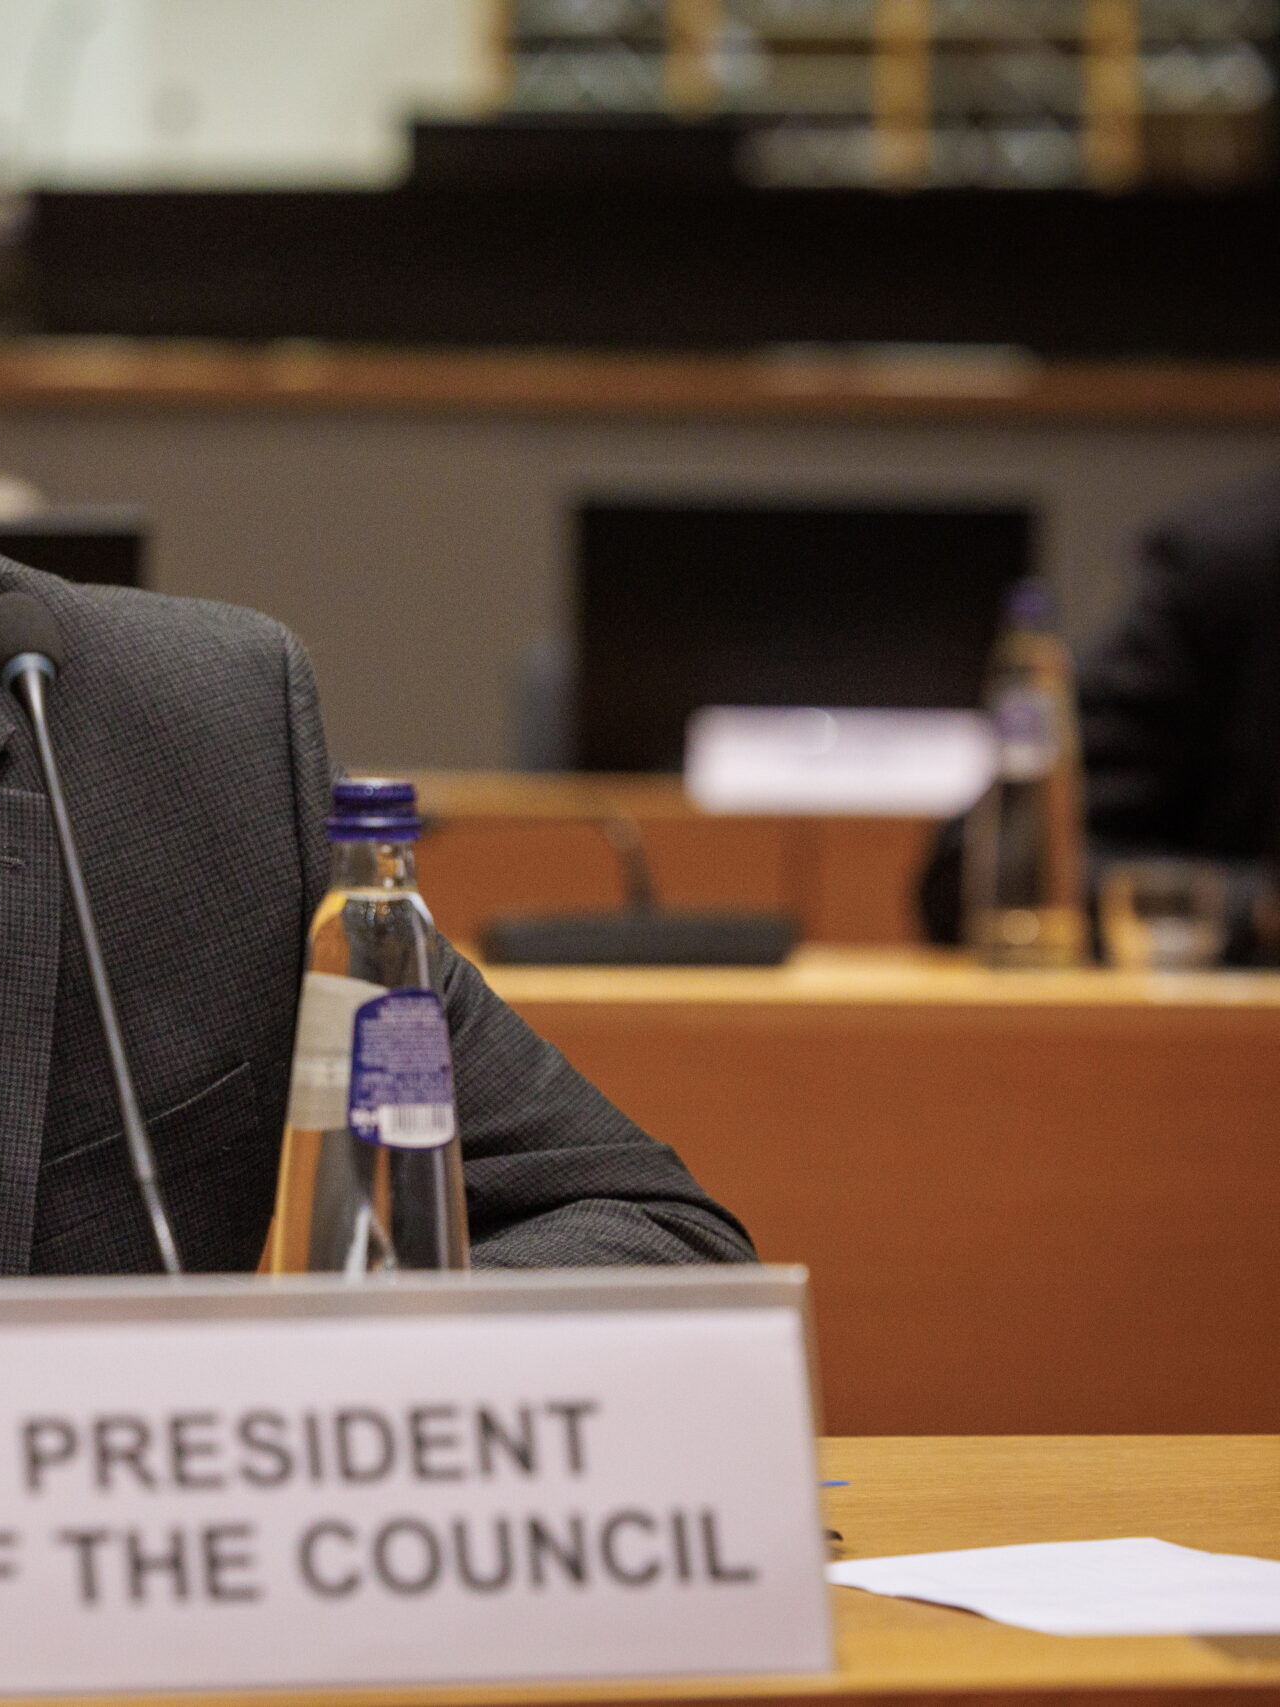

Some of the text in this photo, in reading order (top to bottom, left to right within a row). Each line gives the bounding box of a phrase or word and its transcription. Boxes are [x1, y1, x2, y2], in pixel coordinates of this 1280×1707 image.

[20, 1400, 598, 1492] PRESIDENT
[58, 1526, 260, 1605] THE
[297, 1511, 756, 1600] COUNCIL
